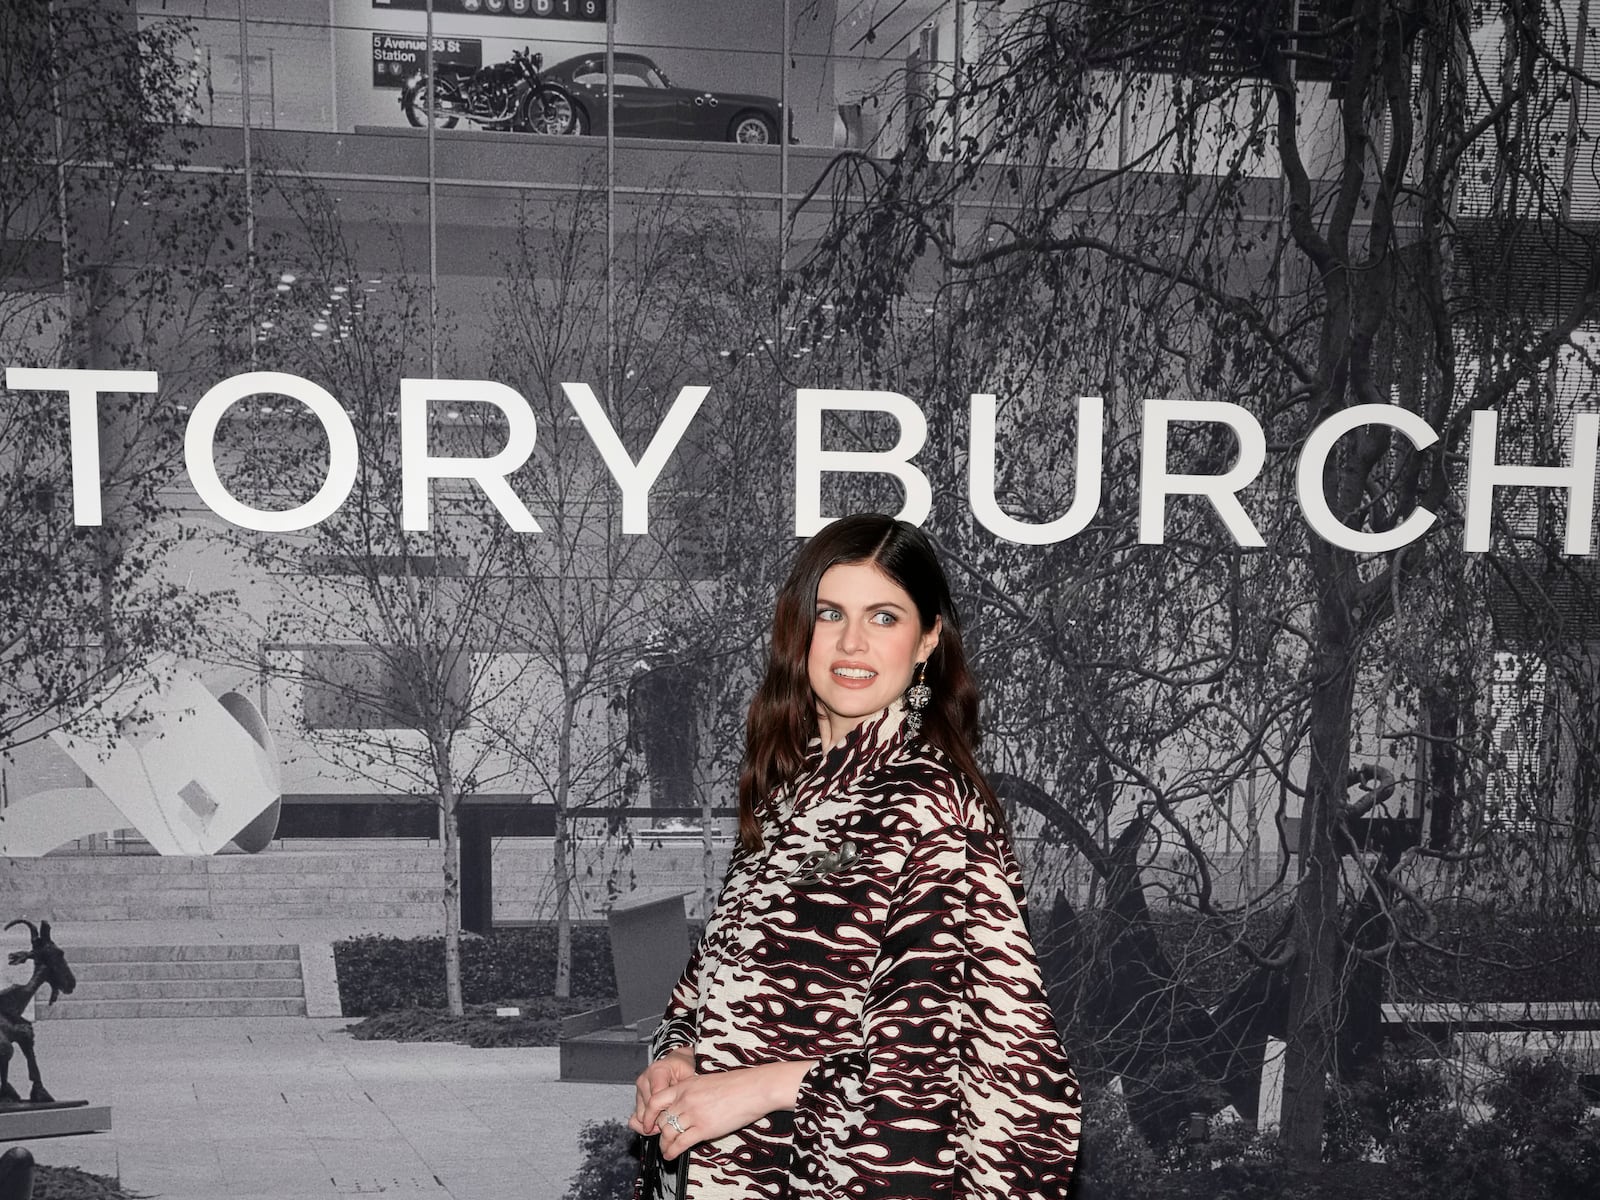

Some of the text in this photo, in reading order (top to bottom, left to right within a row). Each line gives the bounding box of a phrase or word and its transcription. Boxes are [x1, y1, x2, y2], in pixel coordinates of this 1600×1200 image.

[514, 0, 525, 10] B
[537, 0, 549, 11] D
[562, 0, 570, 13] 1
[586, 1, 595, 14] 9
[374, 37, 381, 47] 5
[447, 41, 461, 53] St
[374, 49, 416, 62] Station
[378, 63, 399, 73] E V
[7, 367, 1600, 555] TORY BURCH
